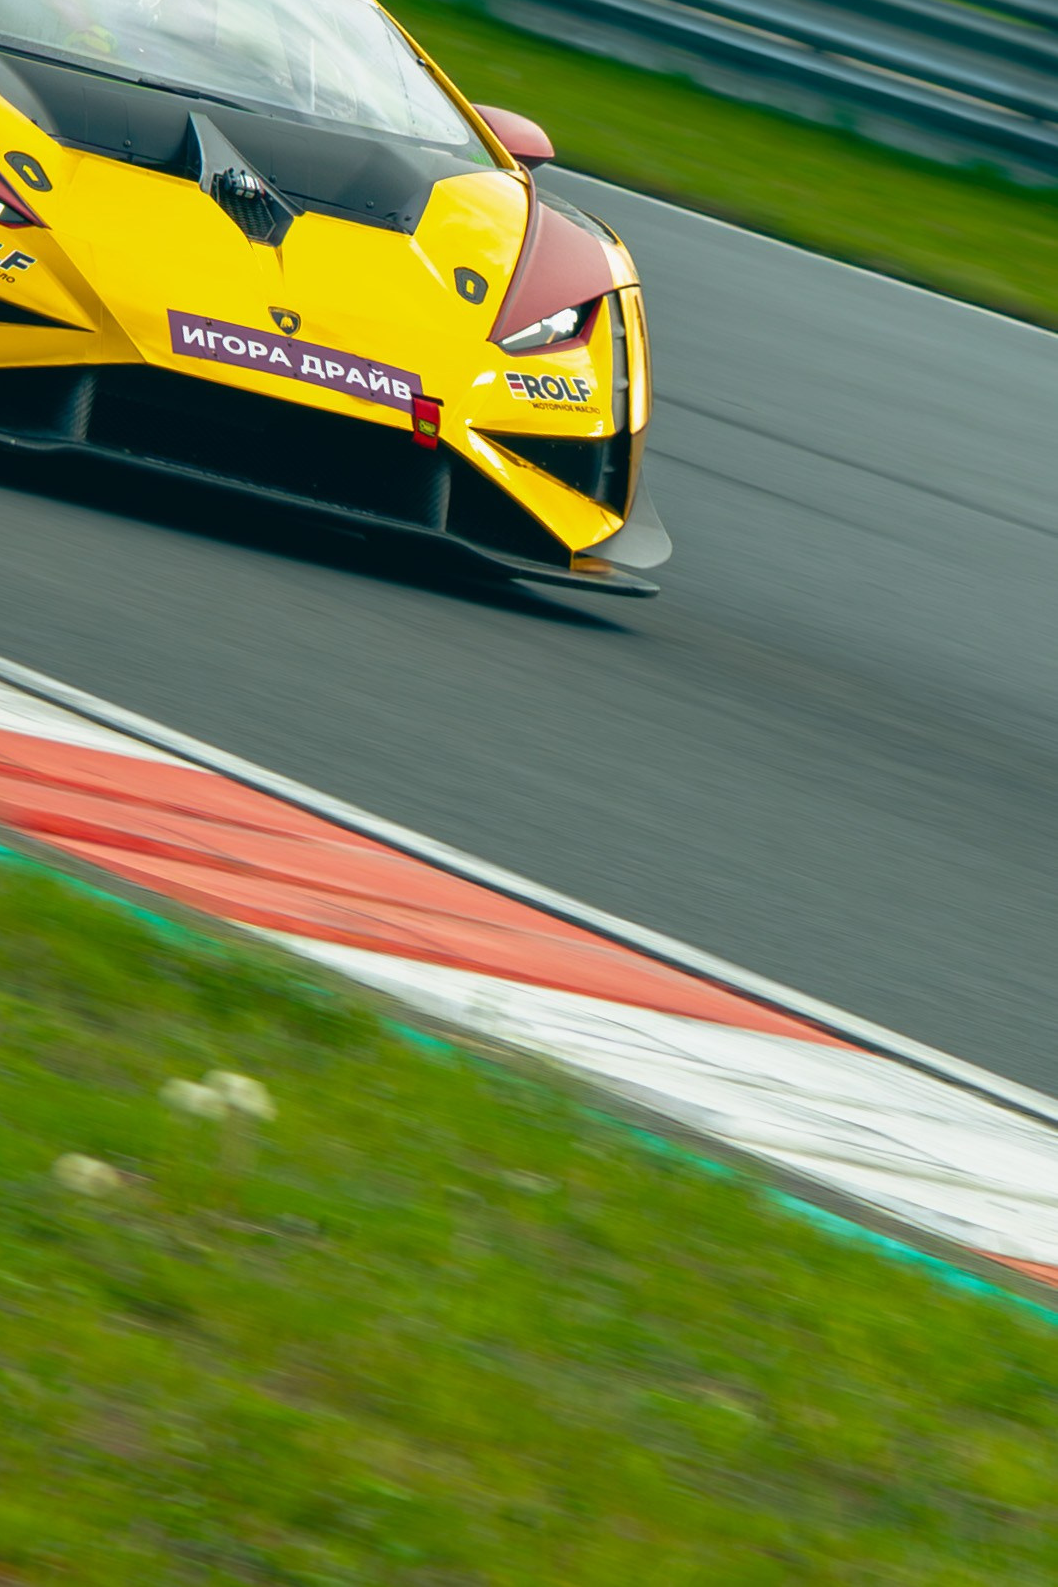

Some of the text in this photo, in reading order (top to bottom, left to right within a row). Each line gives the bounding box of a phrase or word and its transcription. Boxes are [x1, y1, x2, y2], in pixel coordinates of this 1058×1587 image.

[181, 325, 413, 401] ИГОРА ДРАЙВ
[519, 373, 592, 403] ROLF
